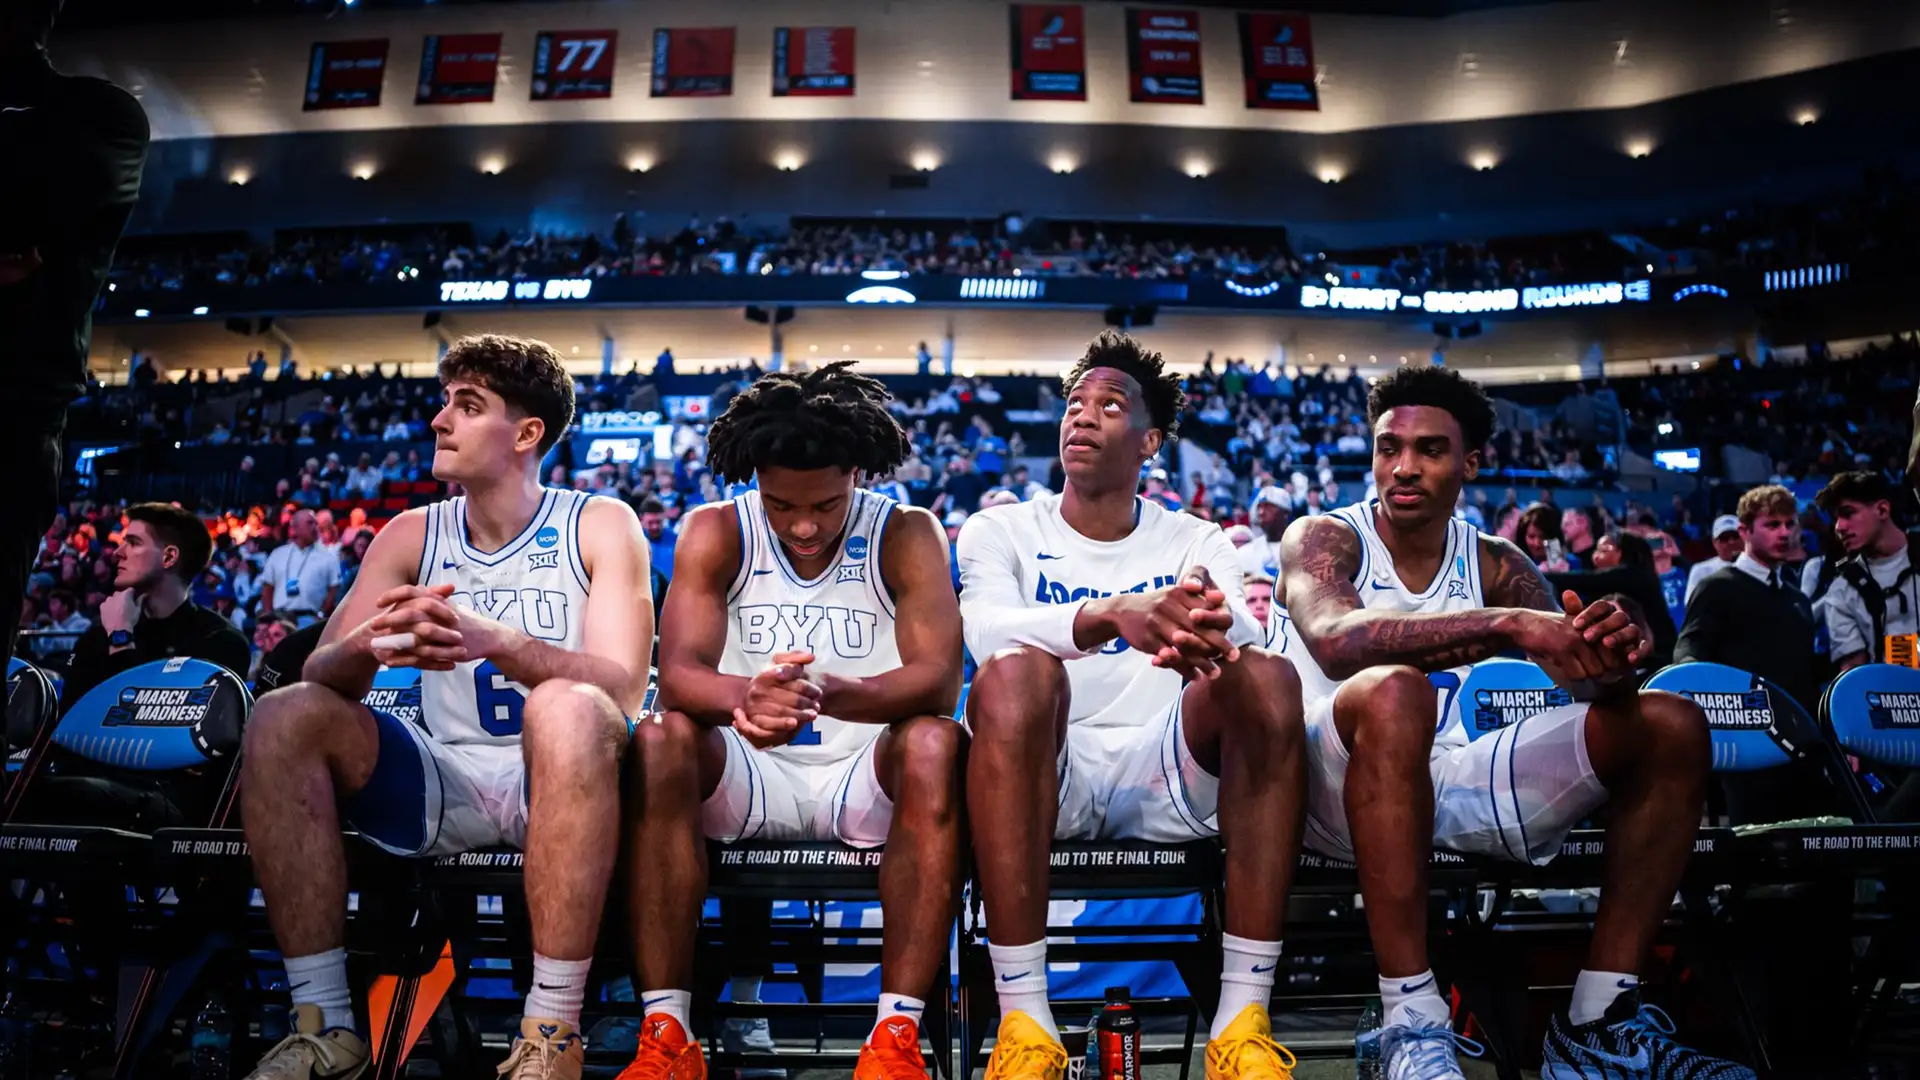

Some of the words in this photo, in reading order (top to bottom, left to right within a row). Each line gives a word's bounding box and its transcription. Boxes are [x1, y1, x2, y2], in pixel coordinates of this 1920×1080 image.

[557, 38, 608, 72] 77
[440, 280, 510, 302] TEXAS
[738, 604, 877, 659] BYU
[134, 690, 189, 704] MARCH
[474, 658, 526, 736] 6
[1492, 691, 1545, 707] MARCH
[1694, 693, 1743, 709] MARCH
[135, 705, 207, 720] MADNESS
[1704, 709, 1772, 725] MADNESS
[1891, 709, 1920, 723] MAD
[19, 837, 47, 851] FINAL
[49, 838, 78, 852] FOUR
[172, 840, 192, 854] THE
[193, 841, 223, 855] ROAD
[226, 842, 240, 855] TO
[1562, 842, 1583, 856] THE
[1802, 837, 1821, 850] THE
[1823, 836, 1849, 849] ROAD
[1851, 836, 1863, 849] TO
[1865, 836, 1883, 849] THE
[1885, 836, 1911, 849] FINAL
[459, 852, 491, 867] ROAD
[494, 853, 511, 867] TO
[721, 850, 744, 865] THE
[749, 850, 780, 864] ROAD
[783, 850, 799, 864] TO
[801, 850, 825, 865] THE
[826, 851, 862, 866] FINAL
[1072, 852, 1089, 866] TO
[1091, 851, 1114, 866] THE
[1116, 851, 1151, 865] FINAL
[1153, 850, 1186, 865] FOUR
